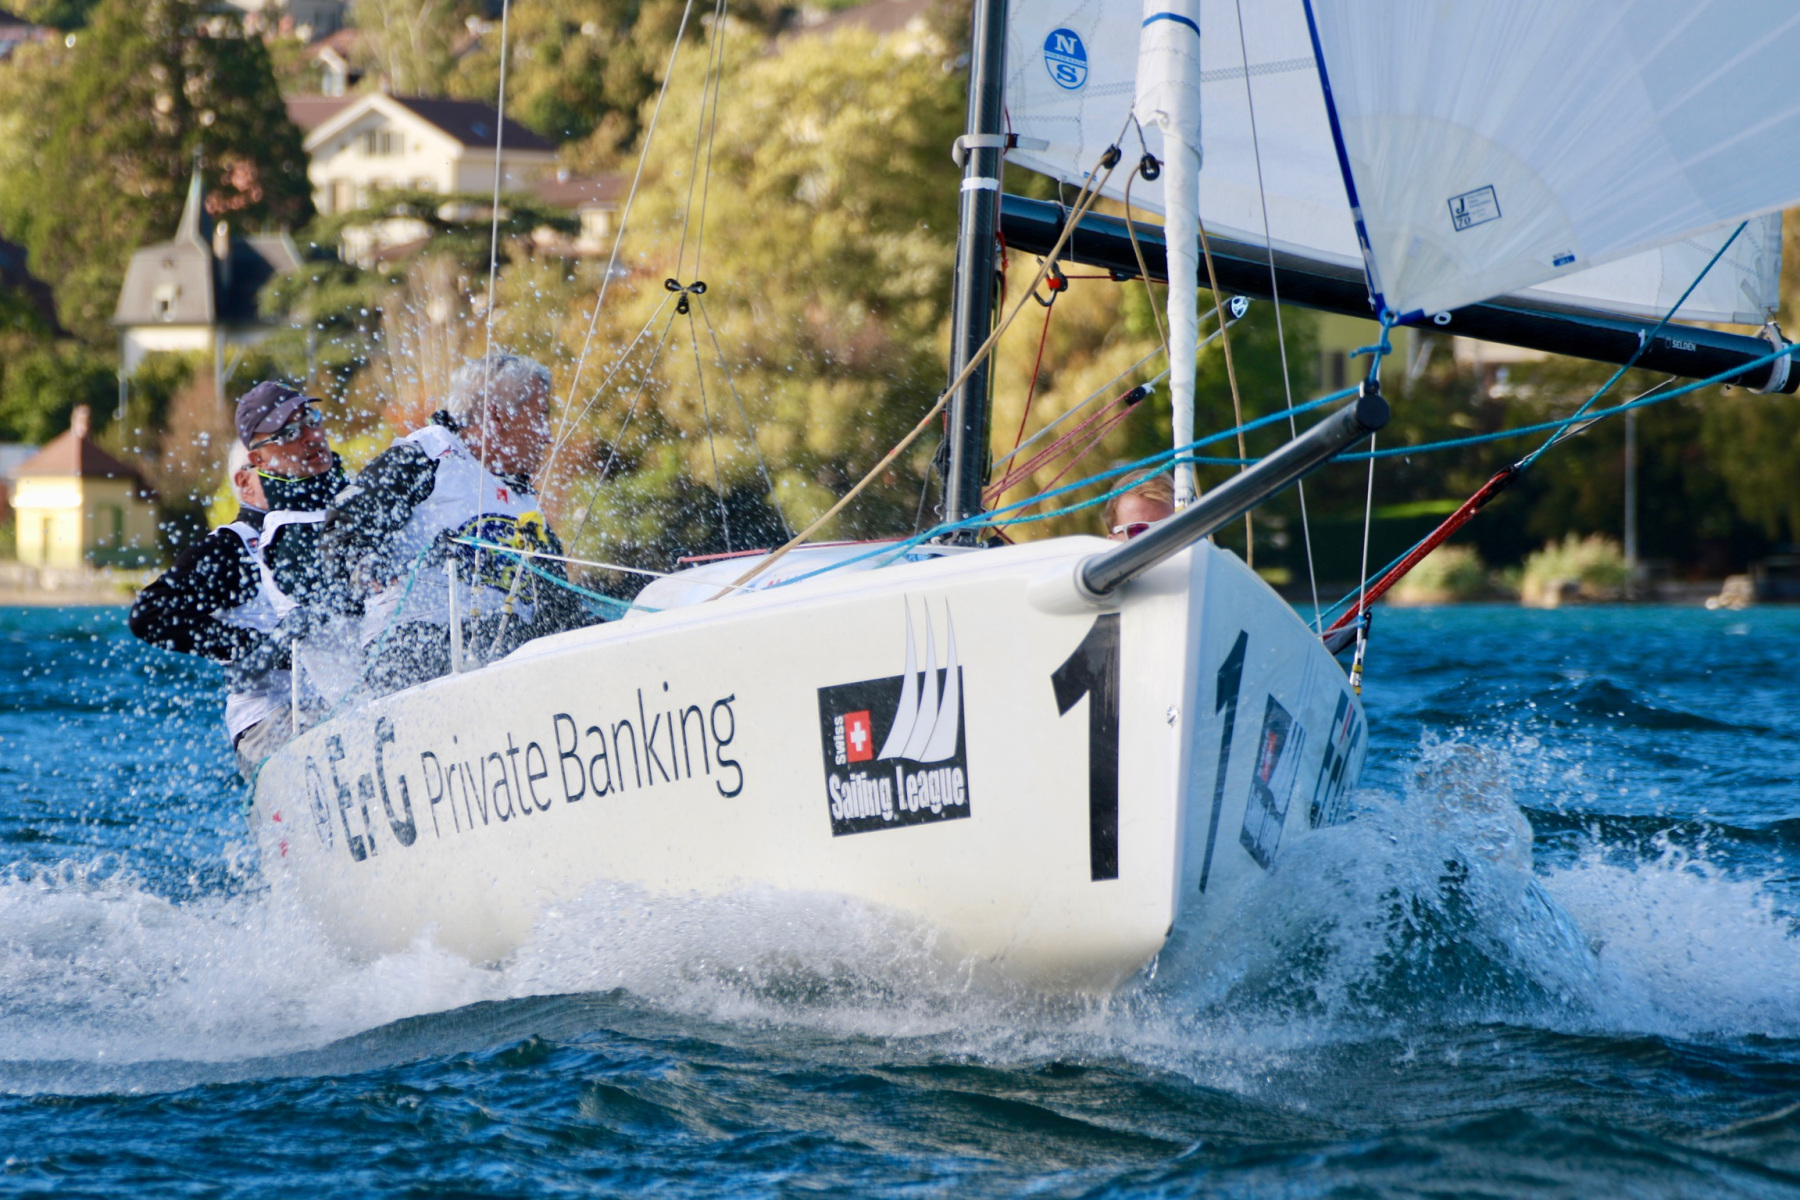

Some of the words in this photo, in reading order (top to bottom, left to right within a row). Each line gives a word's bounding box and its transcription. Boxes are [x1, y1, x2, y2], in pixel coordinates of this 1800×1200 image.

[1055, 33, 1078, 55] N
[1057, 64, 1077, 83] S
[1456, 197, 1465, 214] J
[1456, 216, 1471, 228] 70
[420, 731, 552, 839] Private
[552, 681, 744, 803] Banking
[1050, 612, 1121, 882] 1
[1198, 629, 1249, 894] 1
[829, 771, 894, 822] Sailing
[895, 765, 965, 814] League
